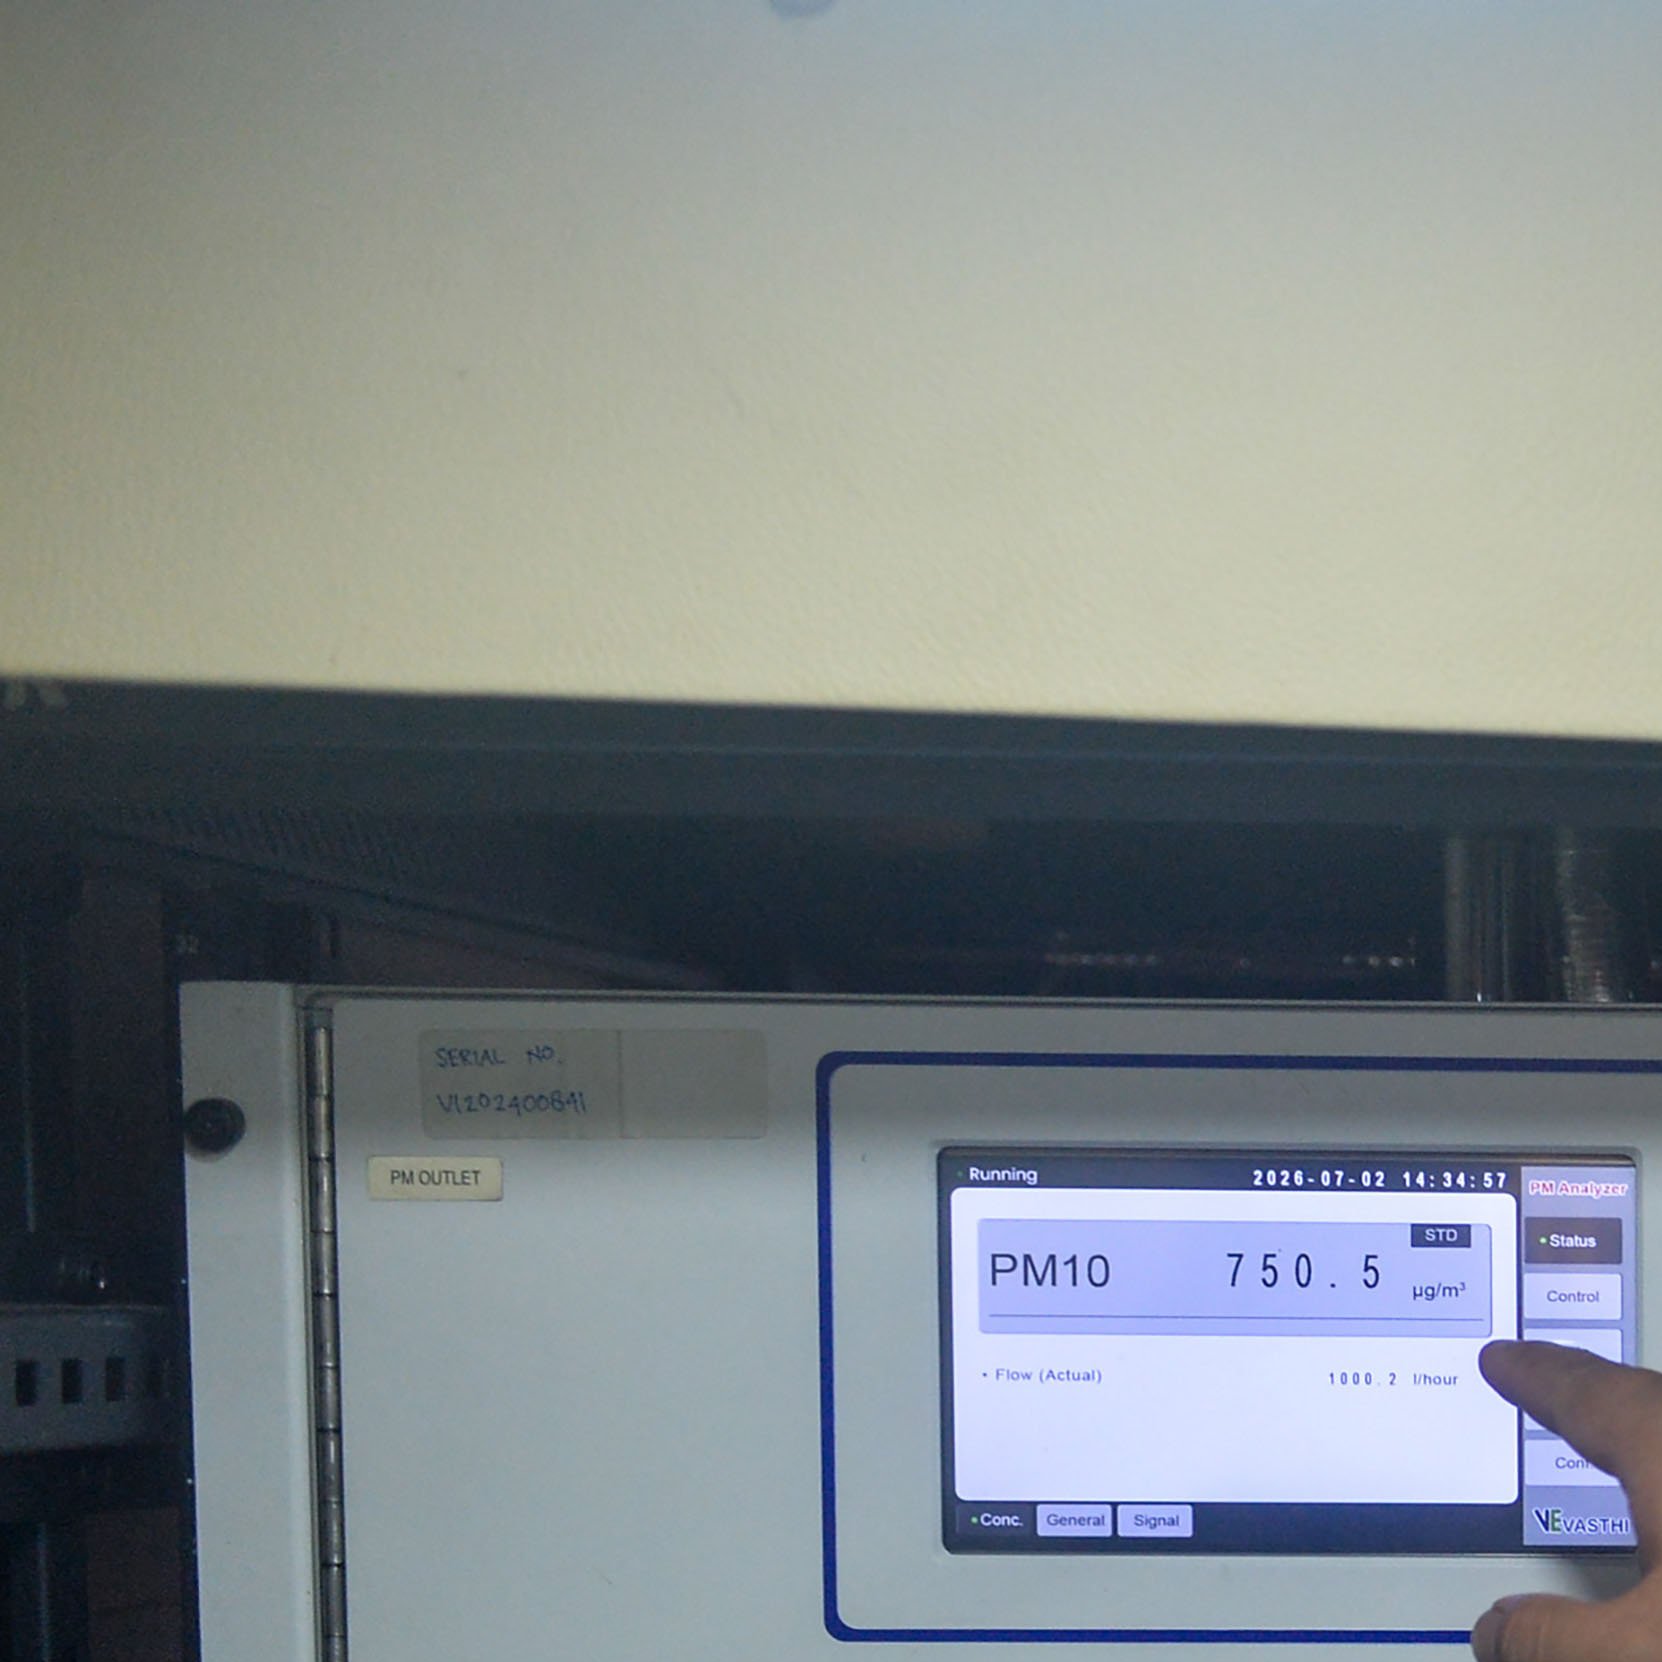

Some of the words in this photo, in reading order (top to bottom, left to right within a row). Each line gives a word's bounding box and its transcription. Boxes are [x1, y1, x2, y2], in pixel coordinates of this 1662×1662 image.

[434, 1046, 506, 1069] SERIAL
[390, 1170, 415, 1186] PM
[418, 1170, 480, 1186] OUTLET
[969, 1167, 1038, 1185] Running
[1253, 1169, 1386, 1188] 2026-07-02
[1402, 1171, 1508, 1189] 14:34:57
[1529, 1181, 1554, 1195] PM
[1558, 1181, 1628, 1199] Analyzer
[1424, 1228, 1458, 1242] STD
[1549, 1234, 1597, 1248] Status
[990, 1253, 1110, 1288] PM10
[1546, 1289, 1600, 1303] Control
[995, 1368, 1033, 1381] Flow
[1039, 1368, 1103, 1385] (Actual)
[980, 1512, 1024, 1527] Conc.
[1046, 1513, 1106, 1527] General
[1133, 1513, 1180, 1529] Signal
